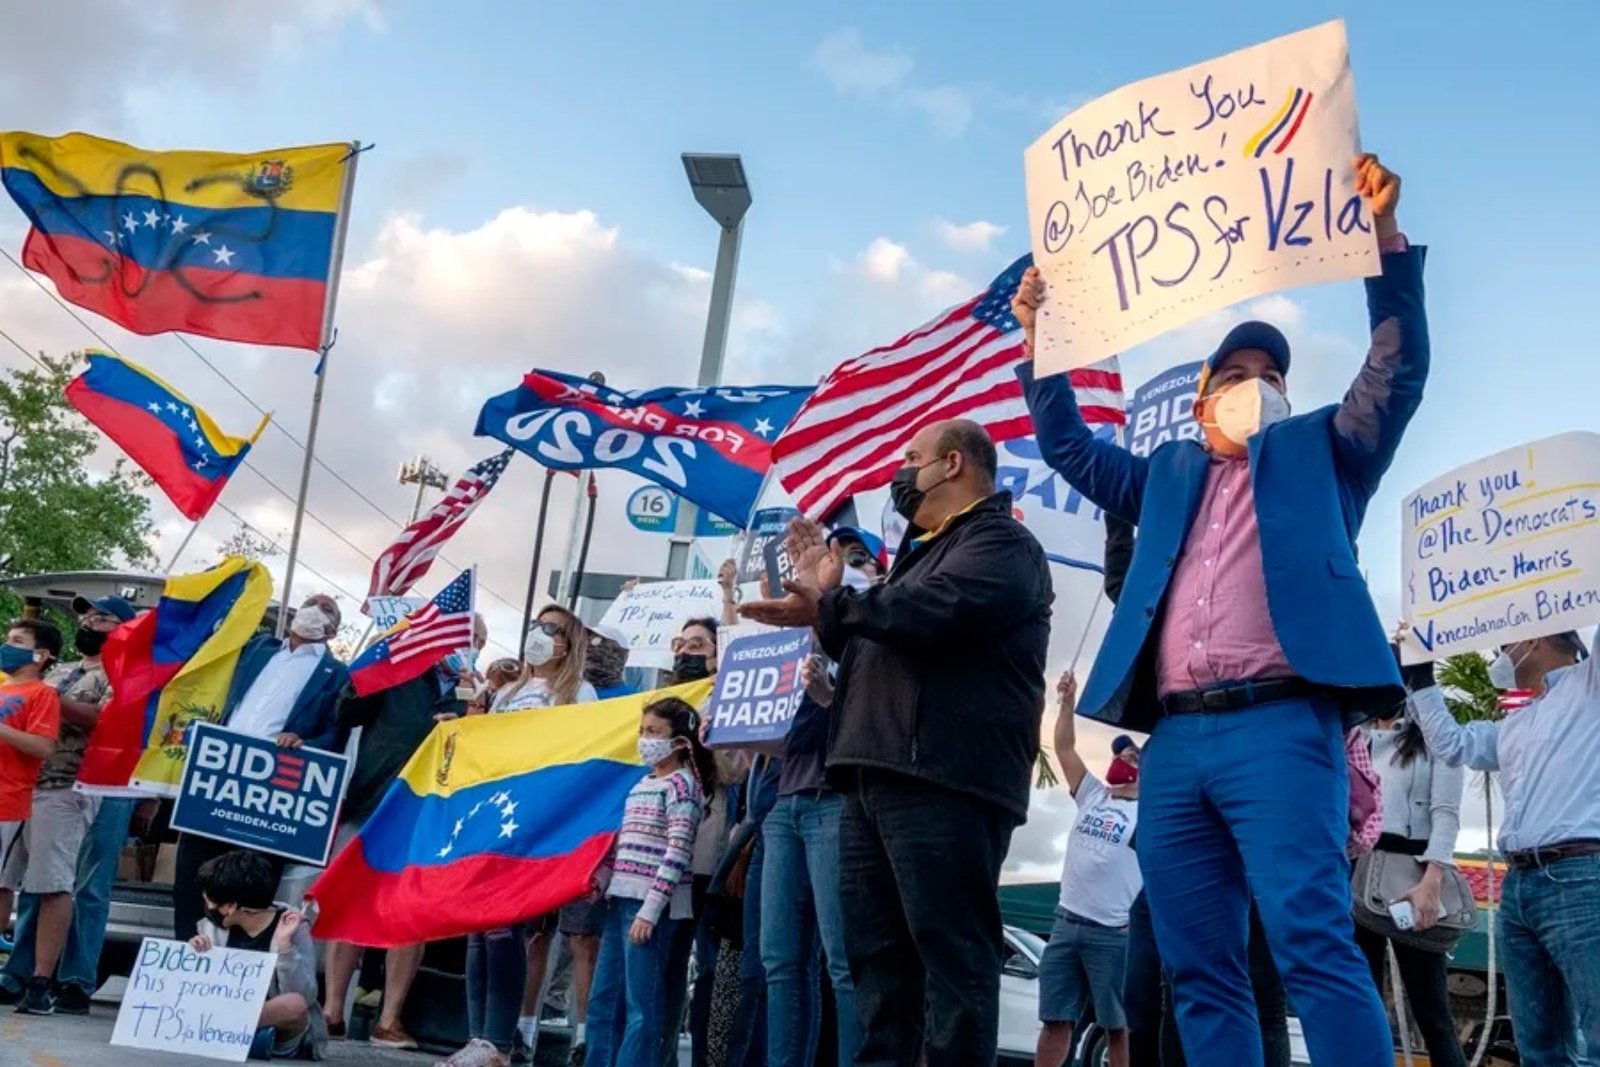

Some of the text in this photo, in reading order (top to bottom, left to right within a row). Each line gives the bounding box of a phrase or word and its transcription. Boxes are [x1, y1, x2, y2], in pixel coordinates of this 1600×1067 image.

[1052, 75, 1265, 181] Thank You
[1092, 157, 1372, 311] TPS for Vzla
[1142, 372, 1201, 403] VENEZOLA
[1133, 392, 1198, 438] BID
[1130, 421, 1206, 457] HAR
[641, 495, 664, 513] 16
[1409, 480, 1468, 527] Thank
[620, 605, 648, 623] TPS
[195, 735, 338, 797] BIDEN
[188, 770, 330, 828] HARRIS
[210, 807, 298, 836] JOEBIDEN.COM
[1075, 825, 1121, 844] HARRIS
[1081, 814, 1126, 834] BIDEN
[134, 968, 256, 1008] his promise
[132, 1002, 185, 1040] TPS
